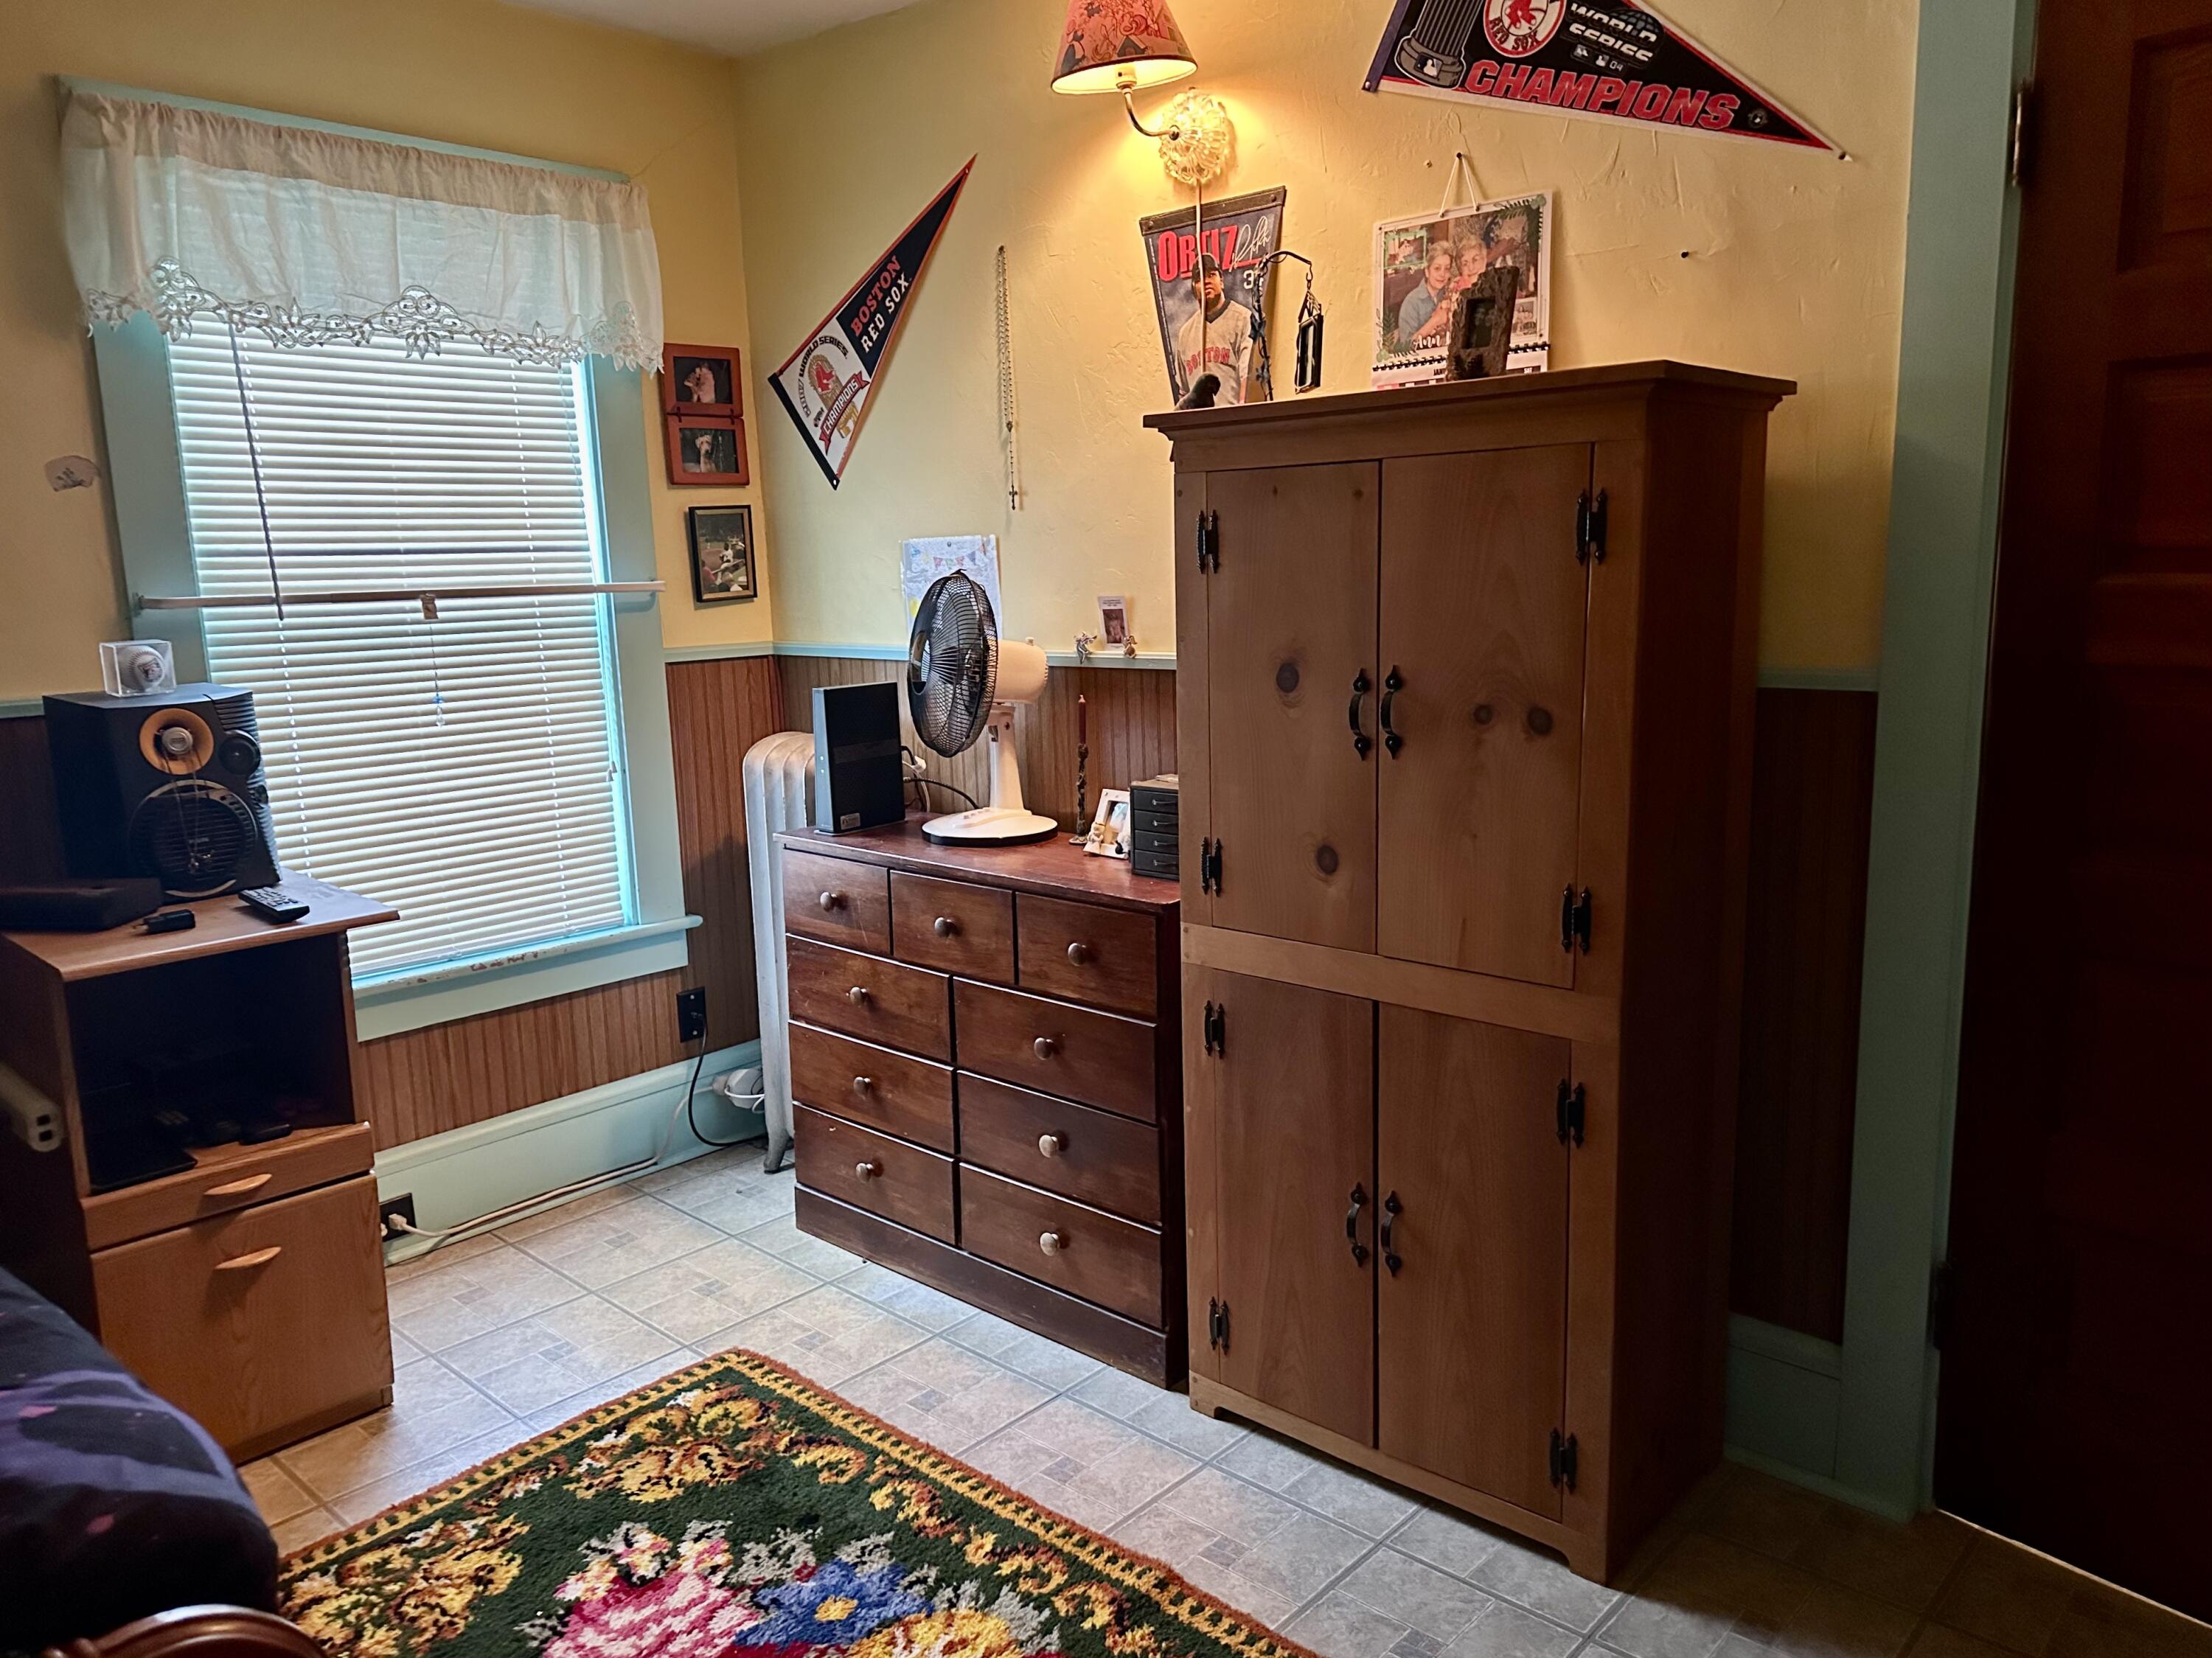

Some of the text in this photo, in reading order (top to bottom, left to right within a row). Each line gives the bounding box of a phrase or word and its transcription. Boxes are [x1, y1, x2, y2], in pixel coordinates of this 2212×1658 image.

[1489, 16, 1542, 51] RED SOX
[1464, 59, 1741, 130] CHAMPIONS
[850, 255, 901, 337] BOSTON
[860, 271, 909, 353] RED SOX
[799, 341, 819, 377] WORLD
[818, 335, 849, 357] SERIES
[823, 378, 859, 435] CHAMPIONS
